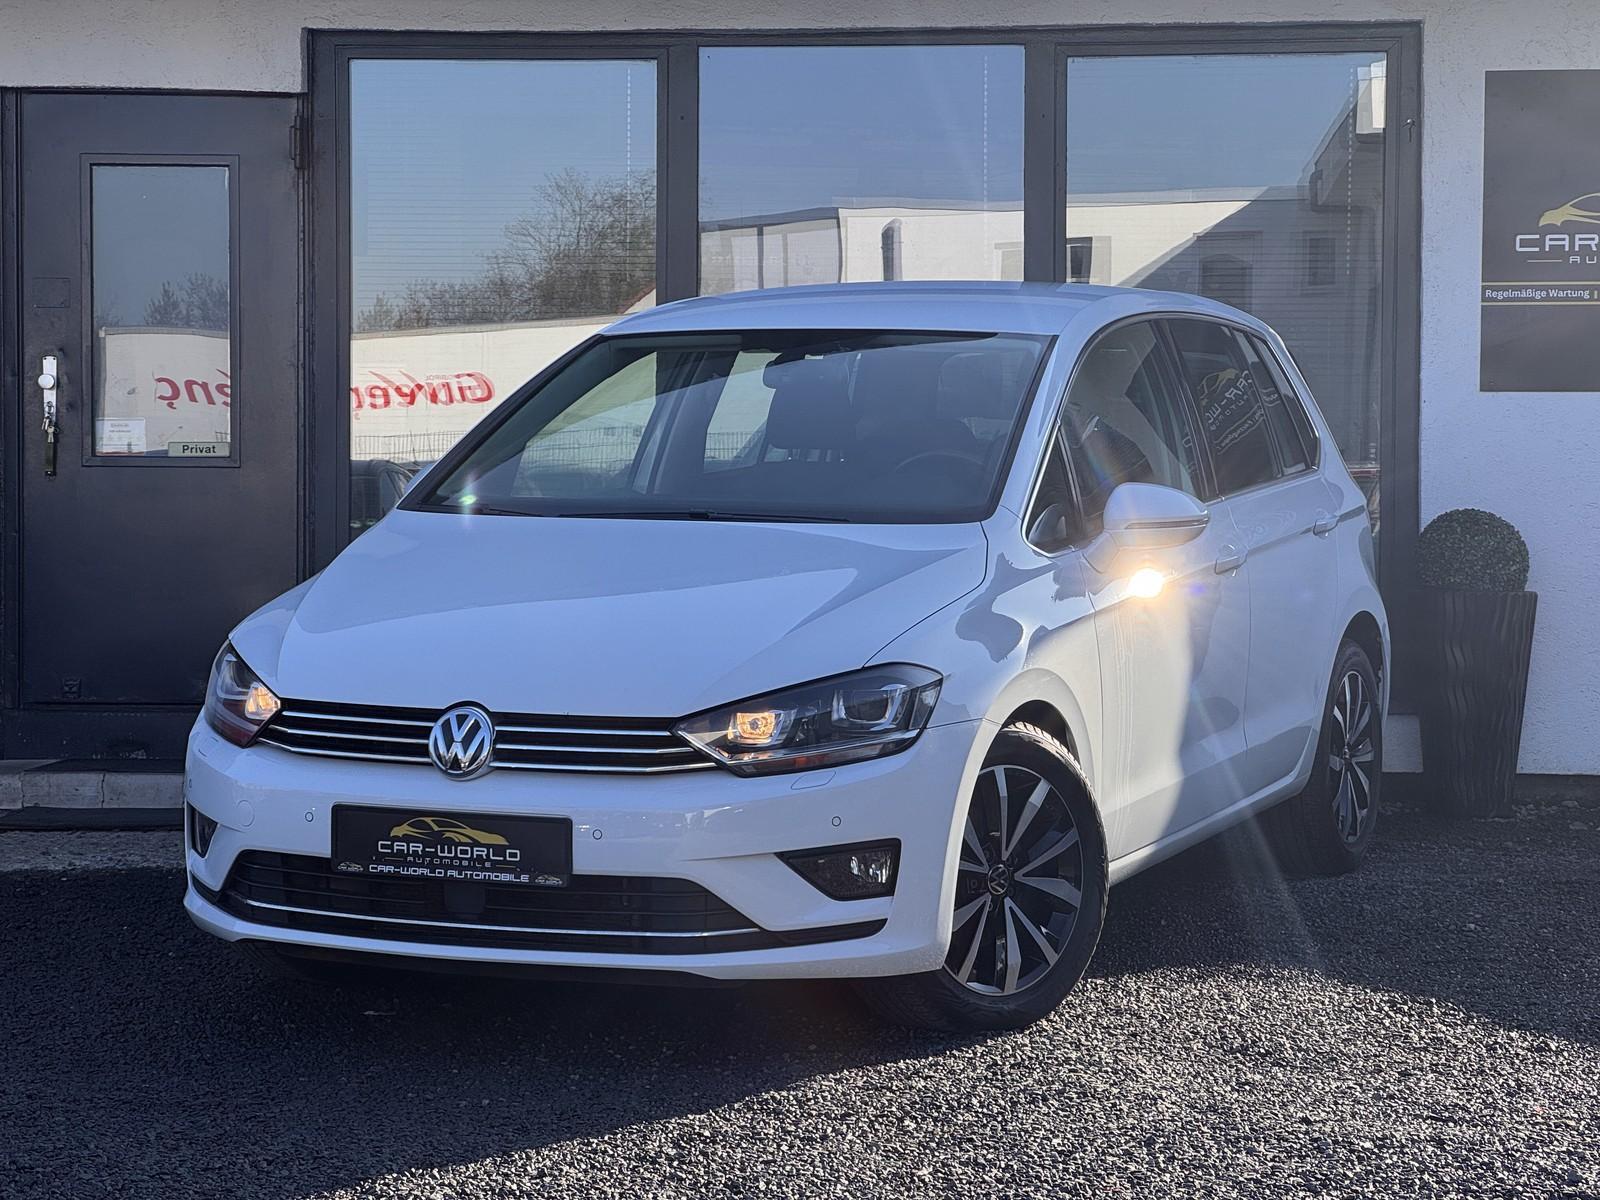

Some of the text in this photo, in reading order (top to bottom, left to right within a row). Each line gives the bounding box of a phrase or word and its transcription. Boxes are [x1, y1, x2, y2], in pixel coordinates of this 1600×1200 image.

[1485, 288, 1590, 300] Regelmäßige Wartung
[182, 444, 216, 454] Privat
[432, 709, 490, 774] VW
[378, 840, 521, 861] CAR-WORLD
[407, 856, 492, 868] AUTOMOBILE
[369, 864, 445, 877] CAR-WORLD
[447, 869, 530, 882] AUTOMOBILE
